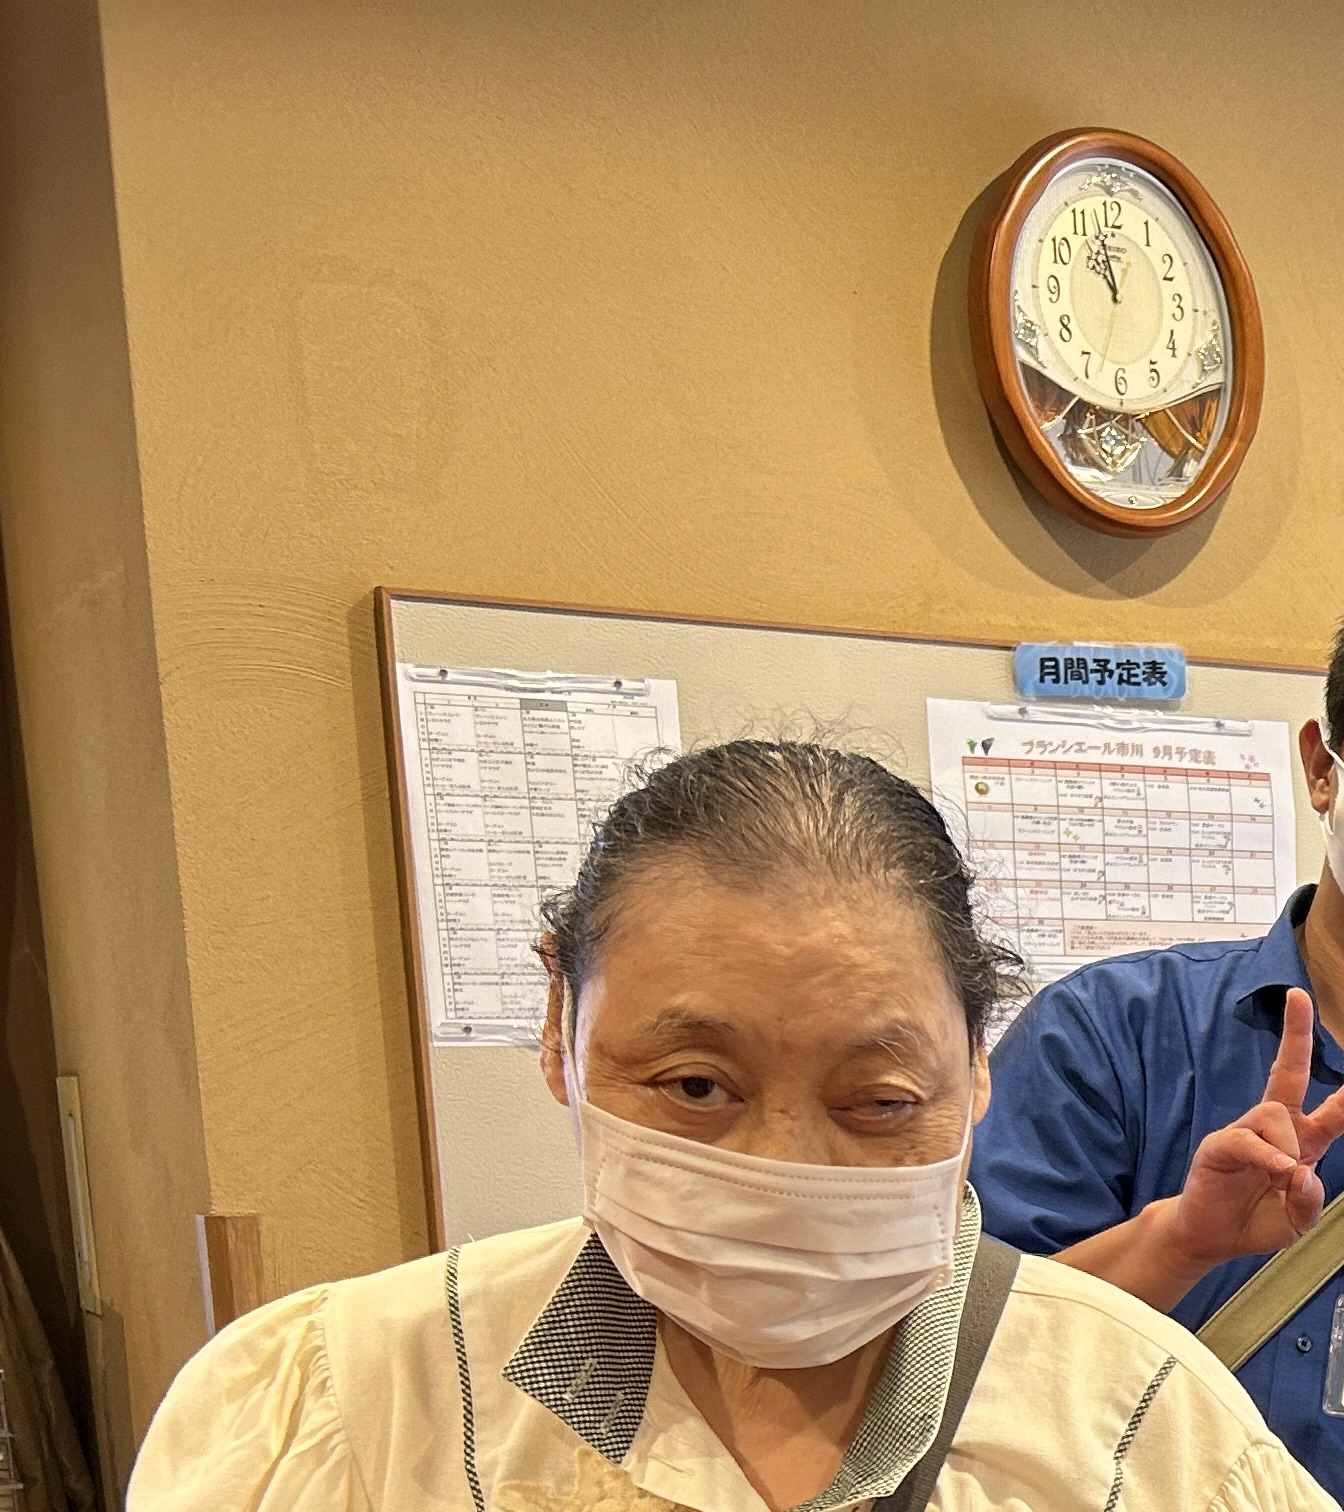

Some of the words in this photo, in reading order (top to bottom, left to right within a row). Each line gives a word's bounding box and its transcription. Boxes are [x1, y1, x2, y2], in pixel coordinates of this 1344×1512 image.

[1071, 207, 1087, 237] 11
[1102, 200, 1123, 230] 12
[1144, 219, 1151, 247] 1
[1051, 236, 1072, 266] 10
[1162, 253, 1176, 282] 2
[1047, 274, 1061, 304] 9
[1171, 293, 1185, 322] 3
[1059, 314, 1072, 343] 8
[1166, 329, 1177, 358] 4
[1081, 350, 1091, 380] 7
[1149, 359, 1161, 389] 5
[1114, 367, 1128, 396] 6
[1039, 656, 1168, 687] 月間予定表
[1021, 740, 1144, 759] ブランシエール市川
